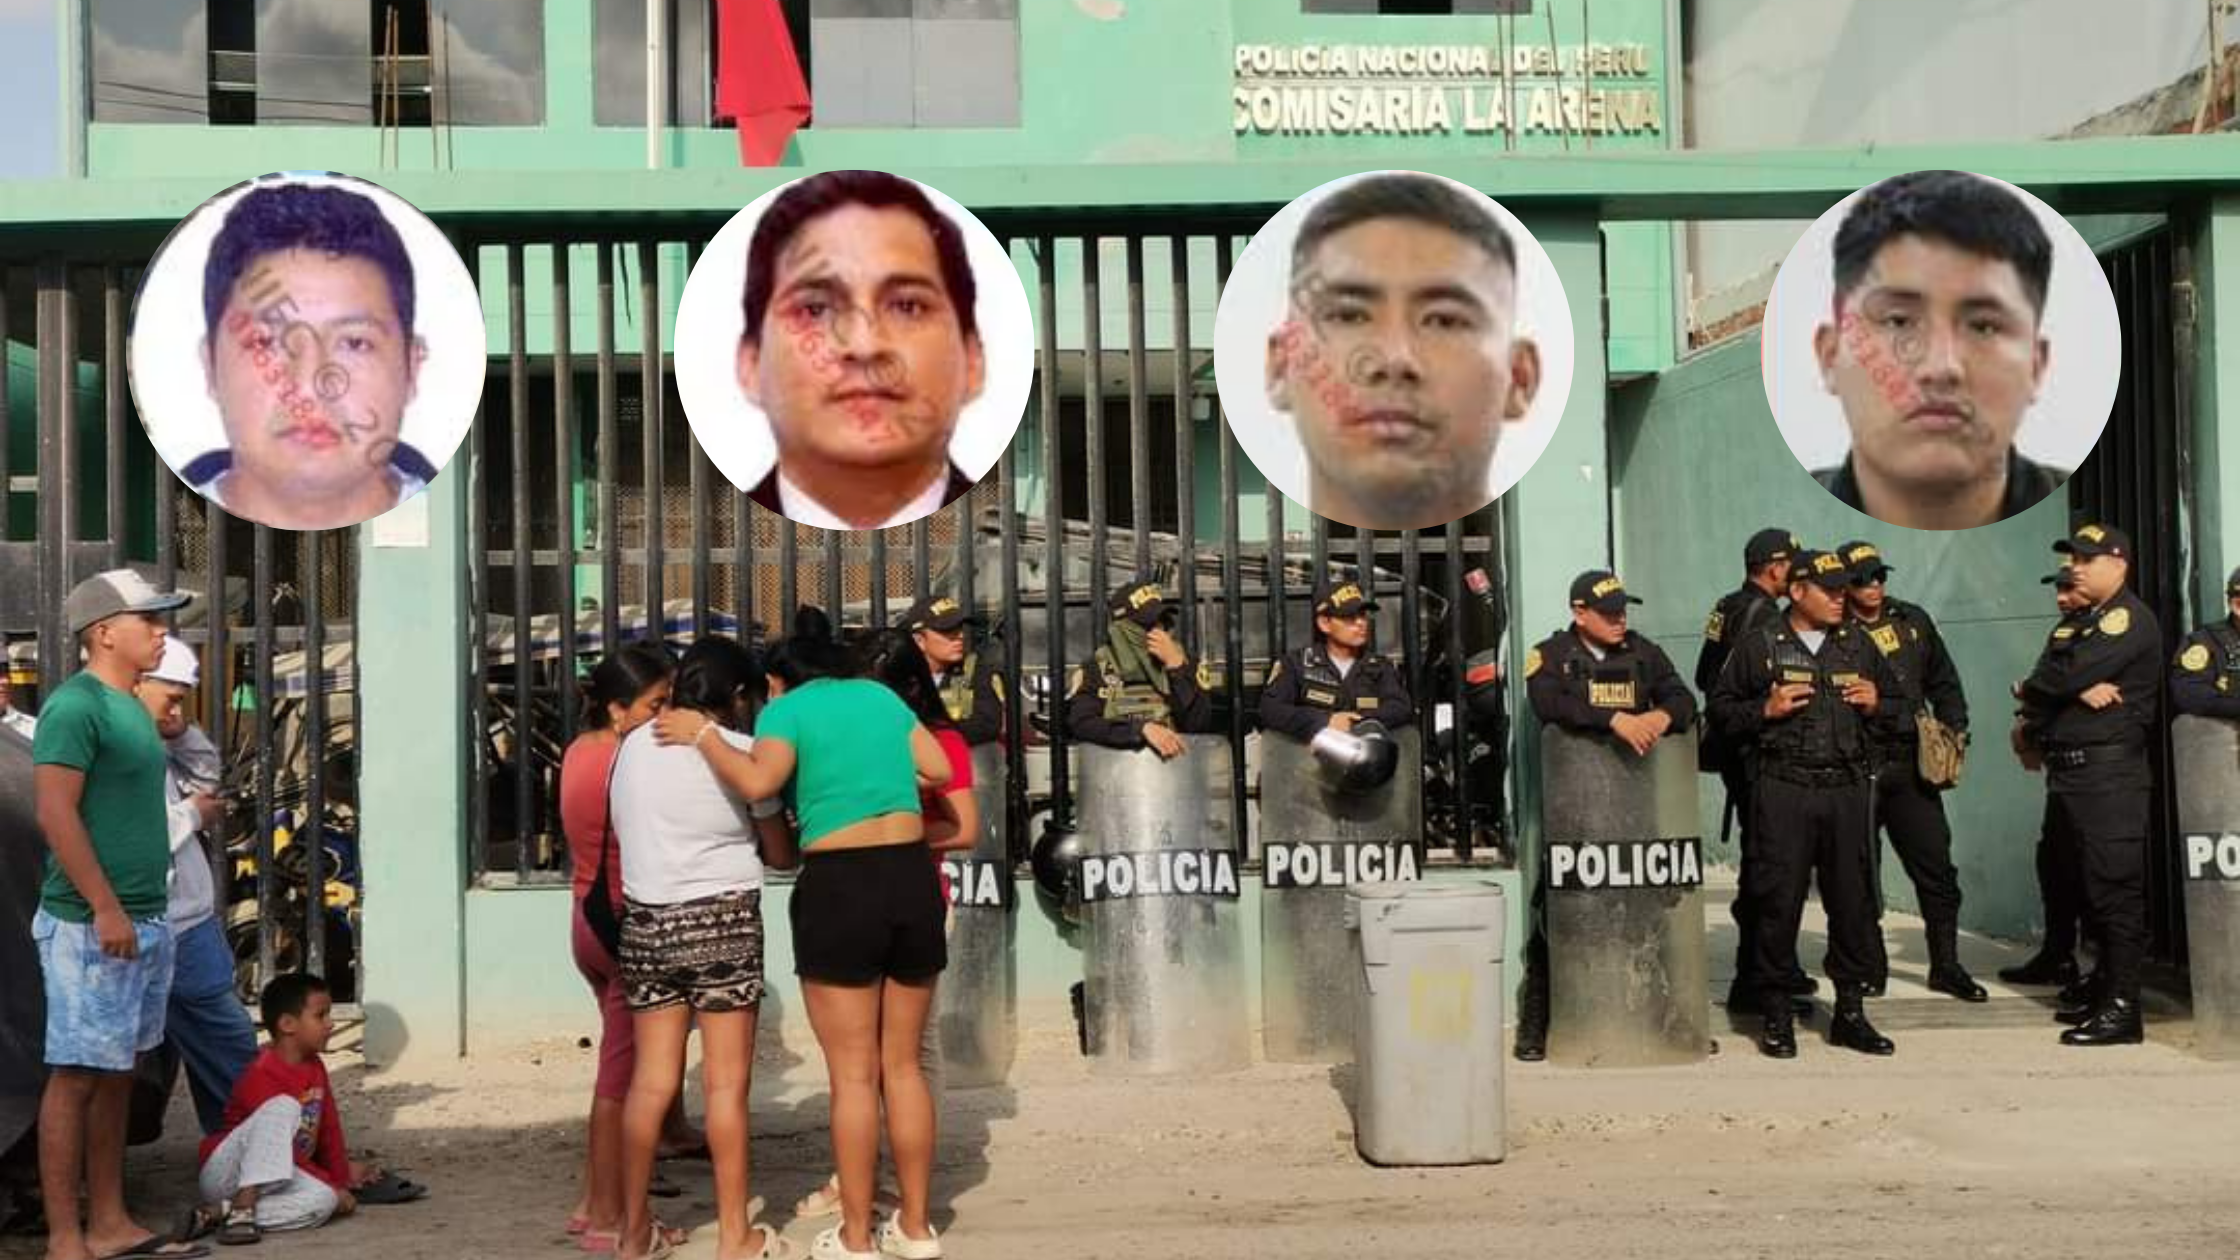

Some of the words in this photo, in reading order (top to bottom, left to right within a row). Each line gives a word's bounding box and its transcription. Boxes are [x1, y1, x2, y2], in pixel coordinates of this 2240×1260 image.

[1357, 45, 1504, 75] NACIONAL
[1512, 45, 1562, 75] DEL
[1463, 82, 1512, 135] LA
[1524, 84, 1660, 136] ARENA
